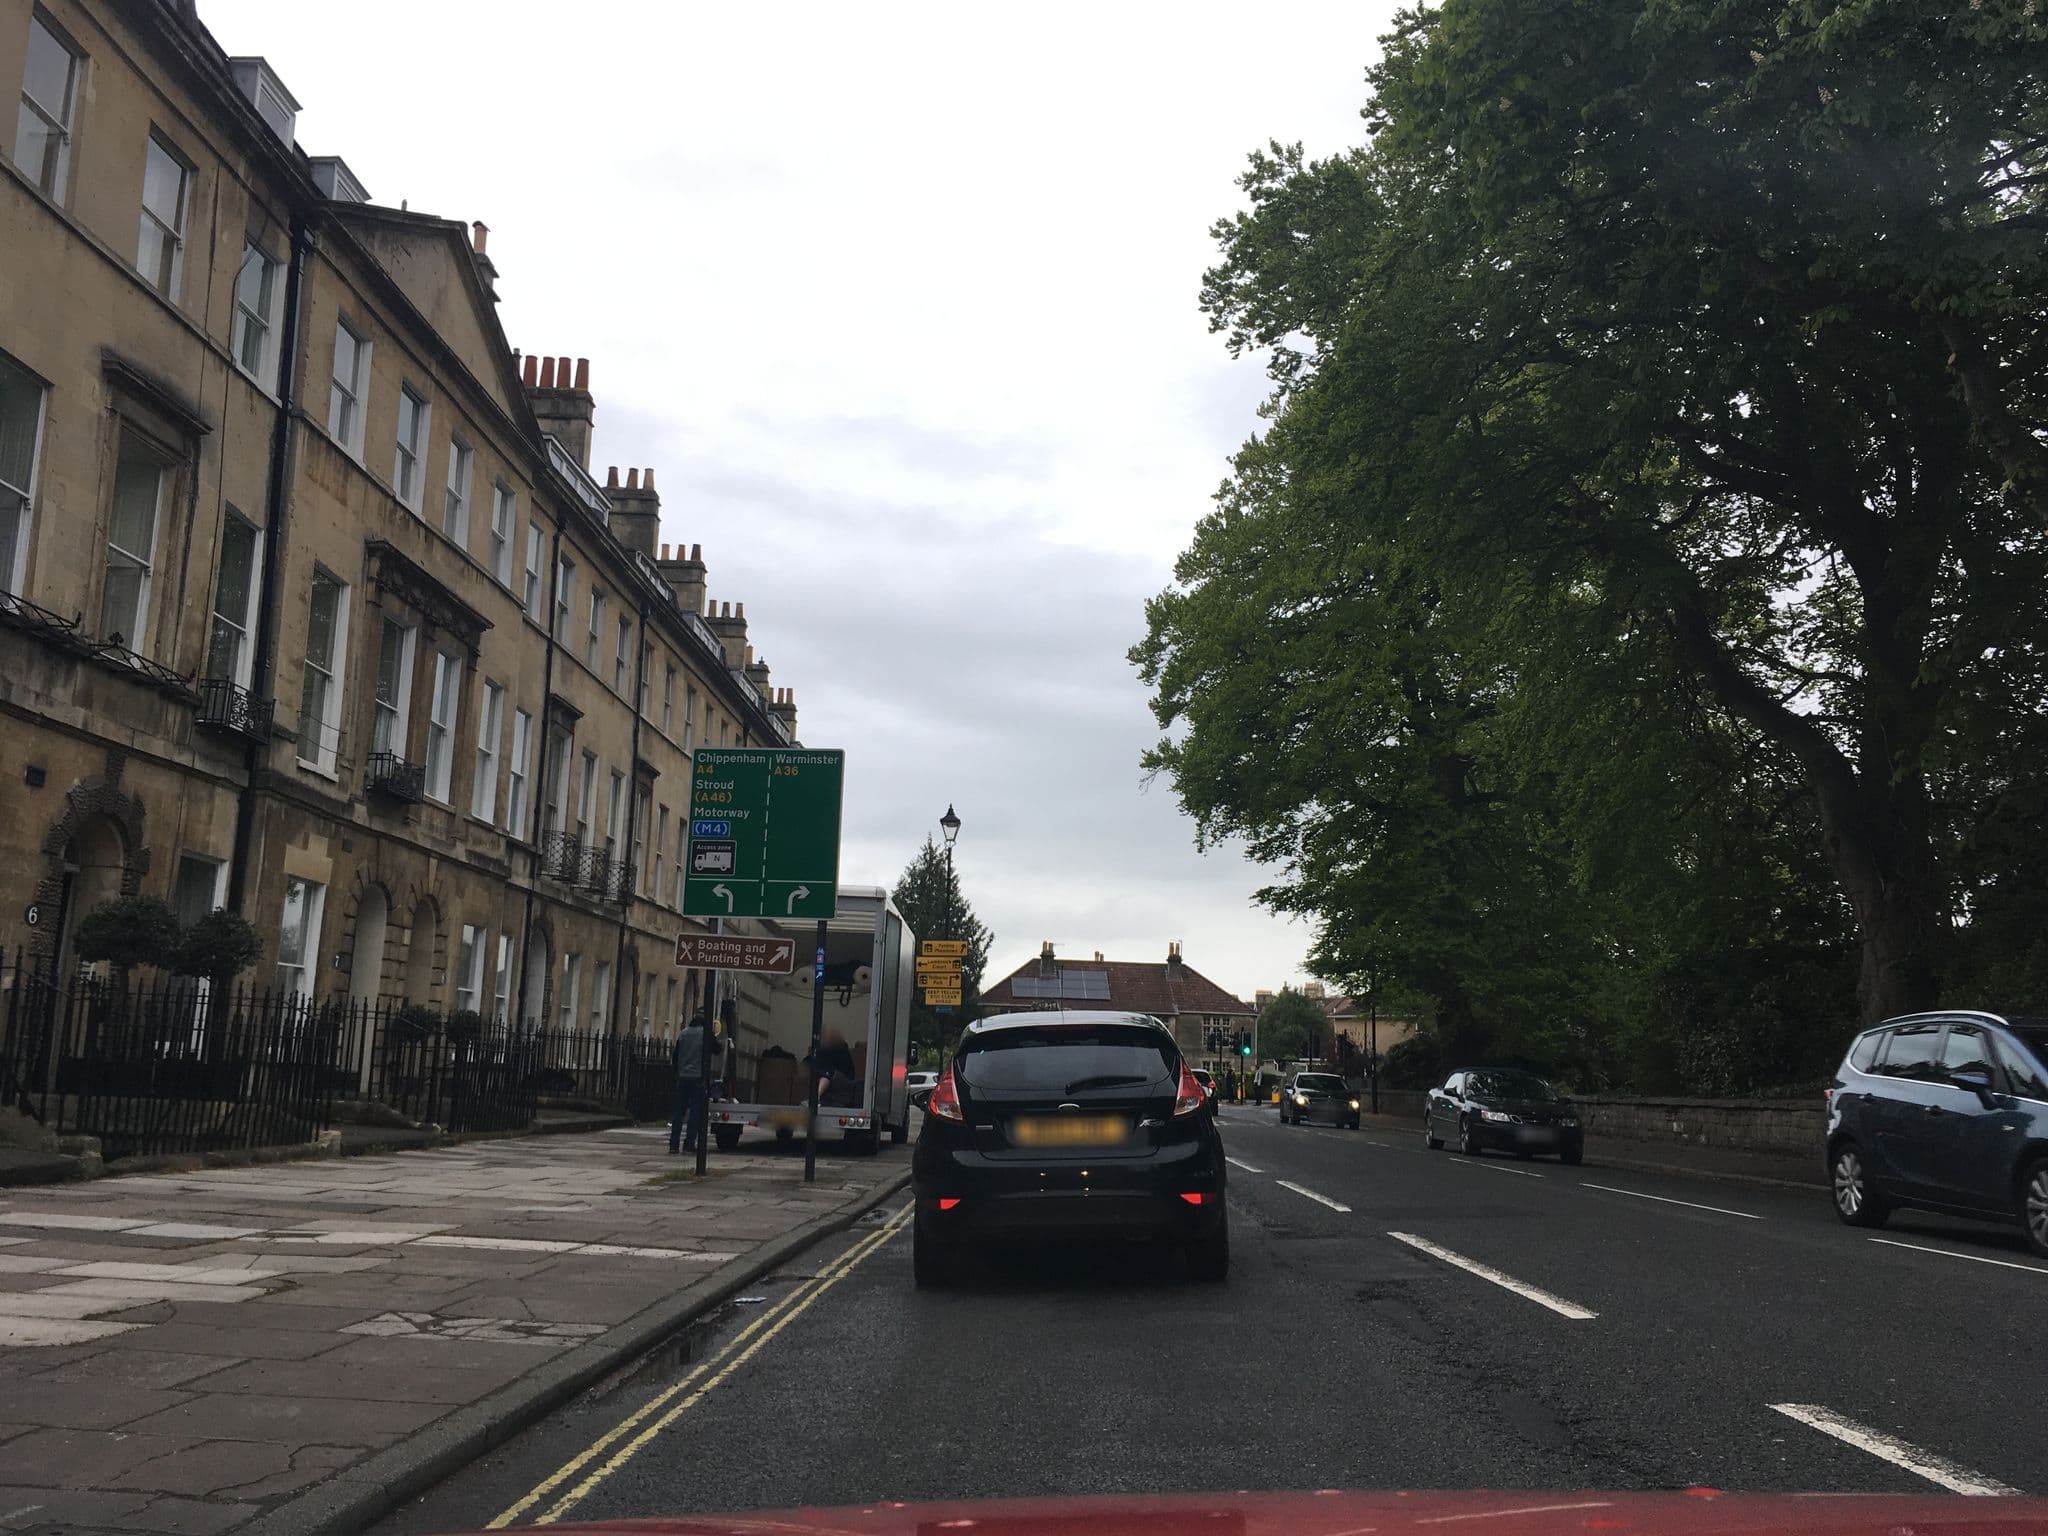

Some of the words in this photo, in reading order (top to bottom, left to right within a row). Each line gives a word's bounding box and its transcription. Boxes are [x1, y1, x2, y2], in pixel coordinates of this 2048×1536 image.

[697, 752, 766, 765] Chippenham
[775, 753, 839, 765] Warminster
[696, 765, 714, 775] A4
[774, 766, 799, 776] A36
[696, 780, 734, 790] Stroud
[695, 792, 732, 803] (A46)
[694, 807, 750, 819] Motorway
[695, 823, 728, 834] (M4)
[713, 854, 721, 863] N
[28, 906, 38, 924] 6
[697, 940, 741, 954] Boating
[744, 943, 766, 954] and
[697, 953, 740, 966] Punting
[744, 954, 765, 966] Stn
